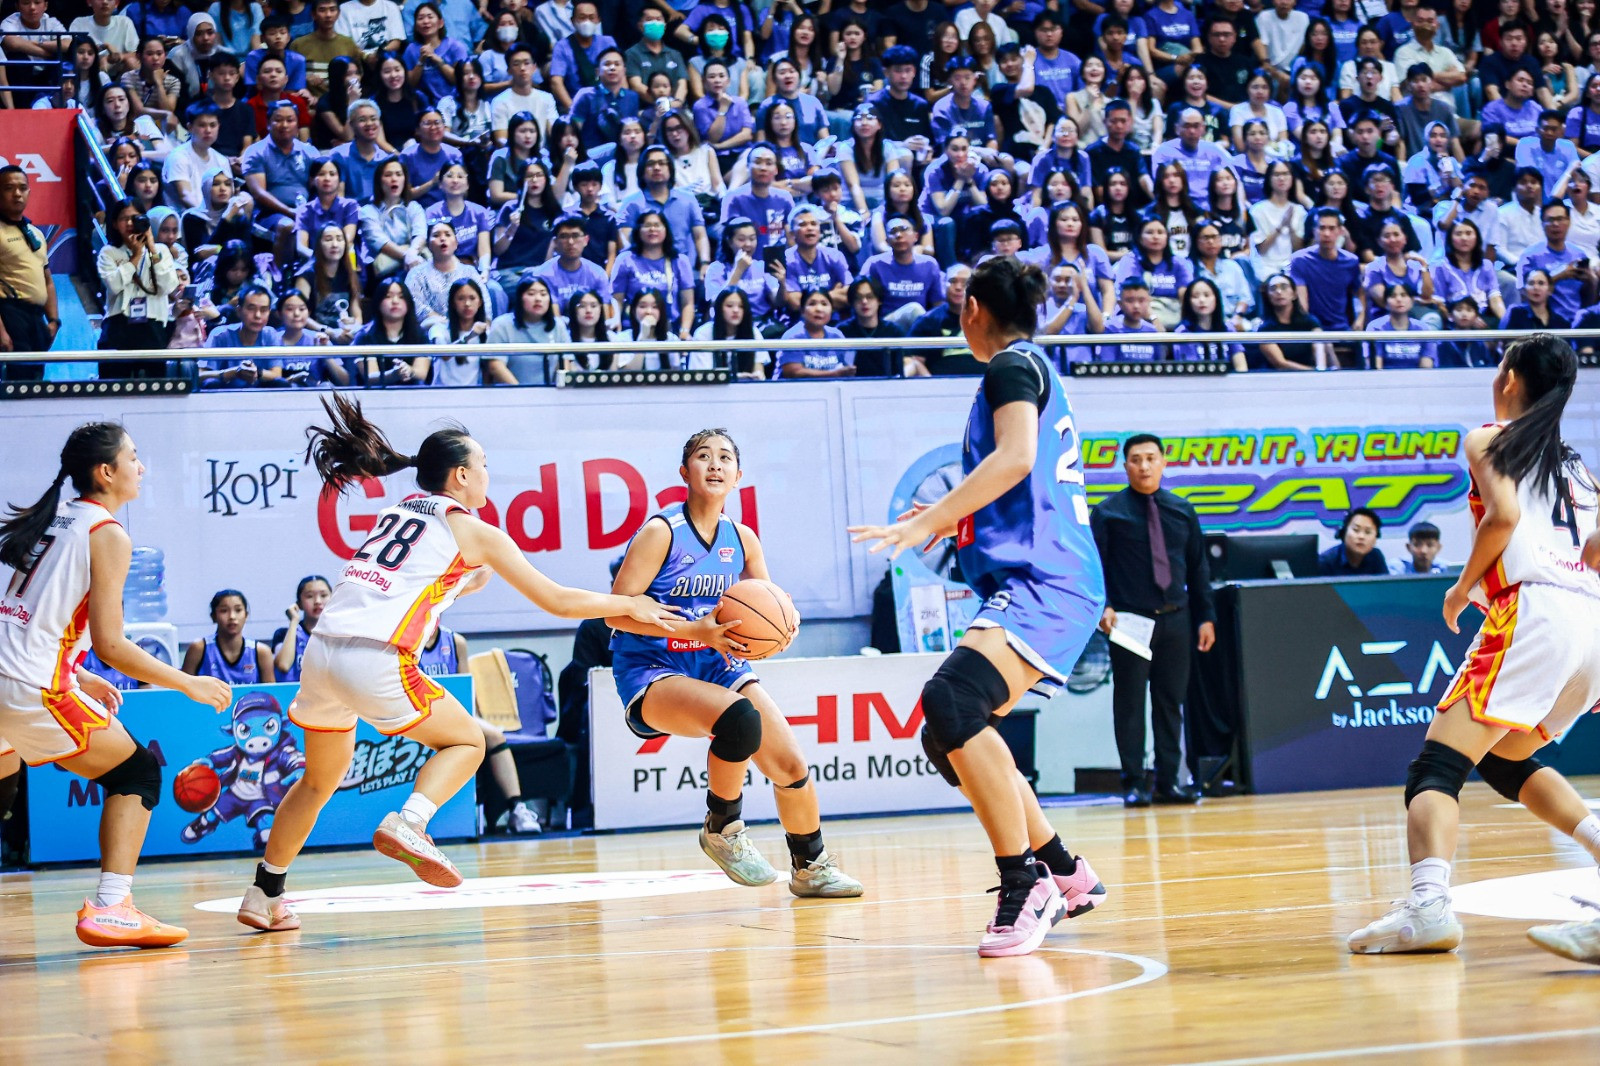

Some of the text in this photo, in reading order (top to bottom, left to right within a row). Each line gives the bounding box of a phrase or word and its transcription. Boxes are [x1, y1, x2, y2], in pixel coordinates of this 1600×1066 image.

[1161, 435, 1256, 467] ORTH
[1314, 433, 1360, 462] YA
[1362, 430, 1460, 461] CUMA
[352, 513, 428, 572] 28
[671, 637, 708, 650] One HEA
[1349, 699, 1438, 729] Jackso
[633, 767, 668, 793] PT
[867, 754, 940, 780] Moto
